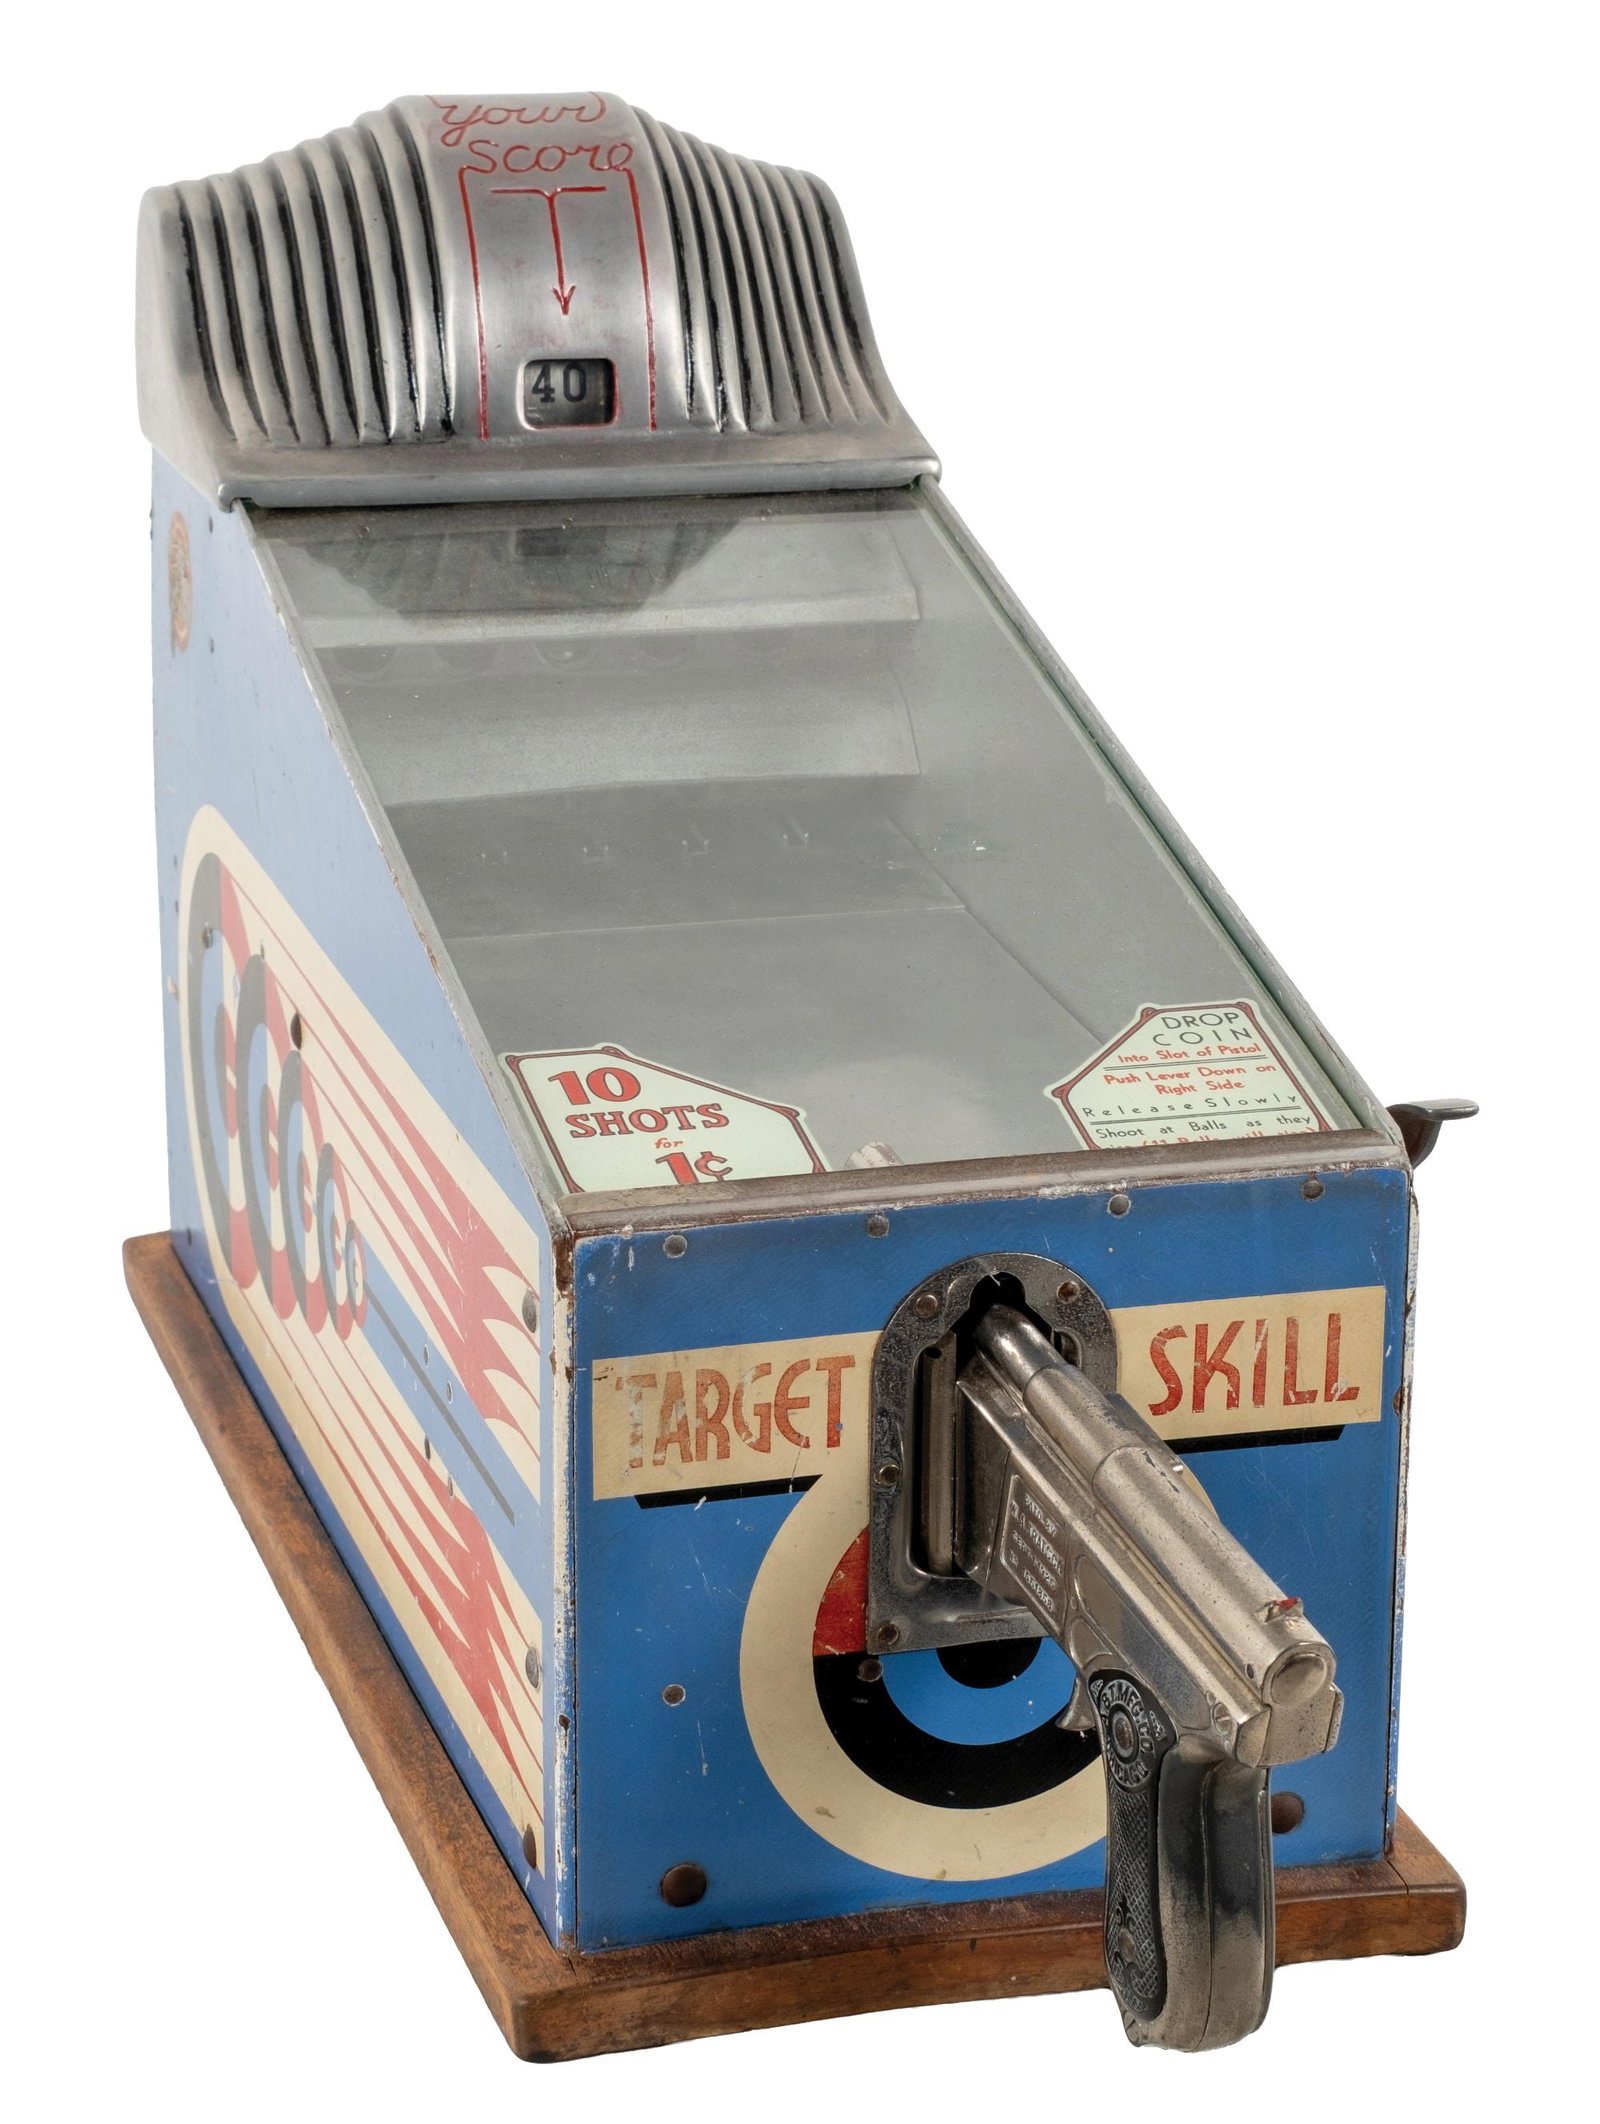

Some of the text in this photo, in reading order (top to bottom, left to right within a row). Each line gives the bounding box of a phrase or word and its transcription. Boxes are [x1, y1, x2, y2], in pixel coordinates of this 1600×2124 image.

[468, 139, 633, 174] Score
[531, 362, 588, 403] 40
[1161, 1012, 1240, 1030] DROP
[1152, 1027, 1253, 1046] COIN
[1117, 1043, 1262, 1064] Into Slot of Pistol
[1103, 1064, 1277, 1085] Push Lever Down on
[547, 1067, 642, 1106] 10
[1155, 1078, 1245, 1096] Right Side
[565, 1103, 730, 1138] SHOTS
[1082, 1103, 1193, 1118] Release
[1096, 1128, 1144, 1139] Shoot
[1160, 1126, 1175, 1134] at
[1189, 1119, 1227, 1132] Balls
[1246, 1120, 1262, 1128] as
[1276, 1115, 1311, 1125] they
[653, 1137, 684, 1150] for
[615, 1312, 1361, 1470] TARGET SKILL
